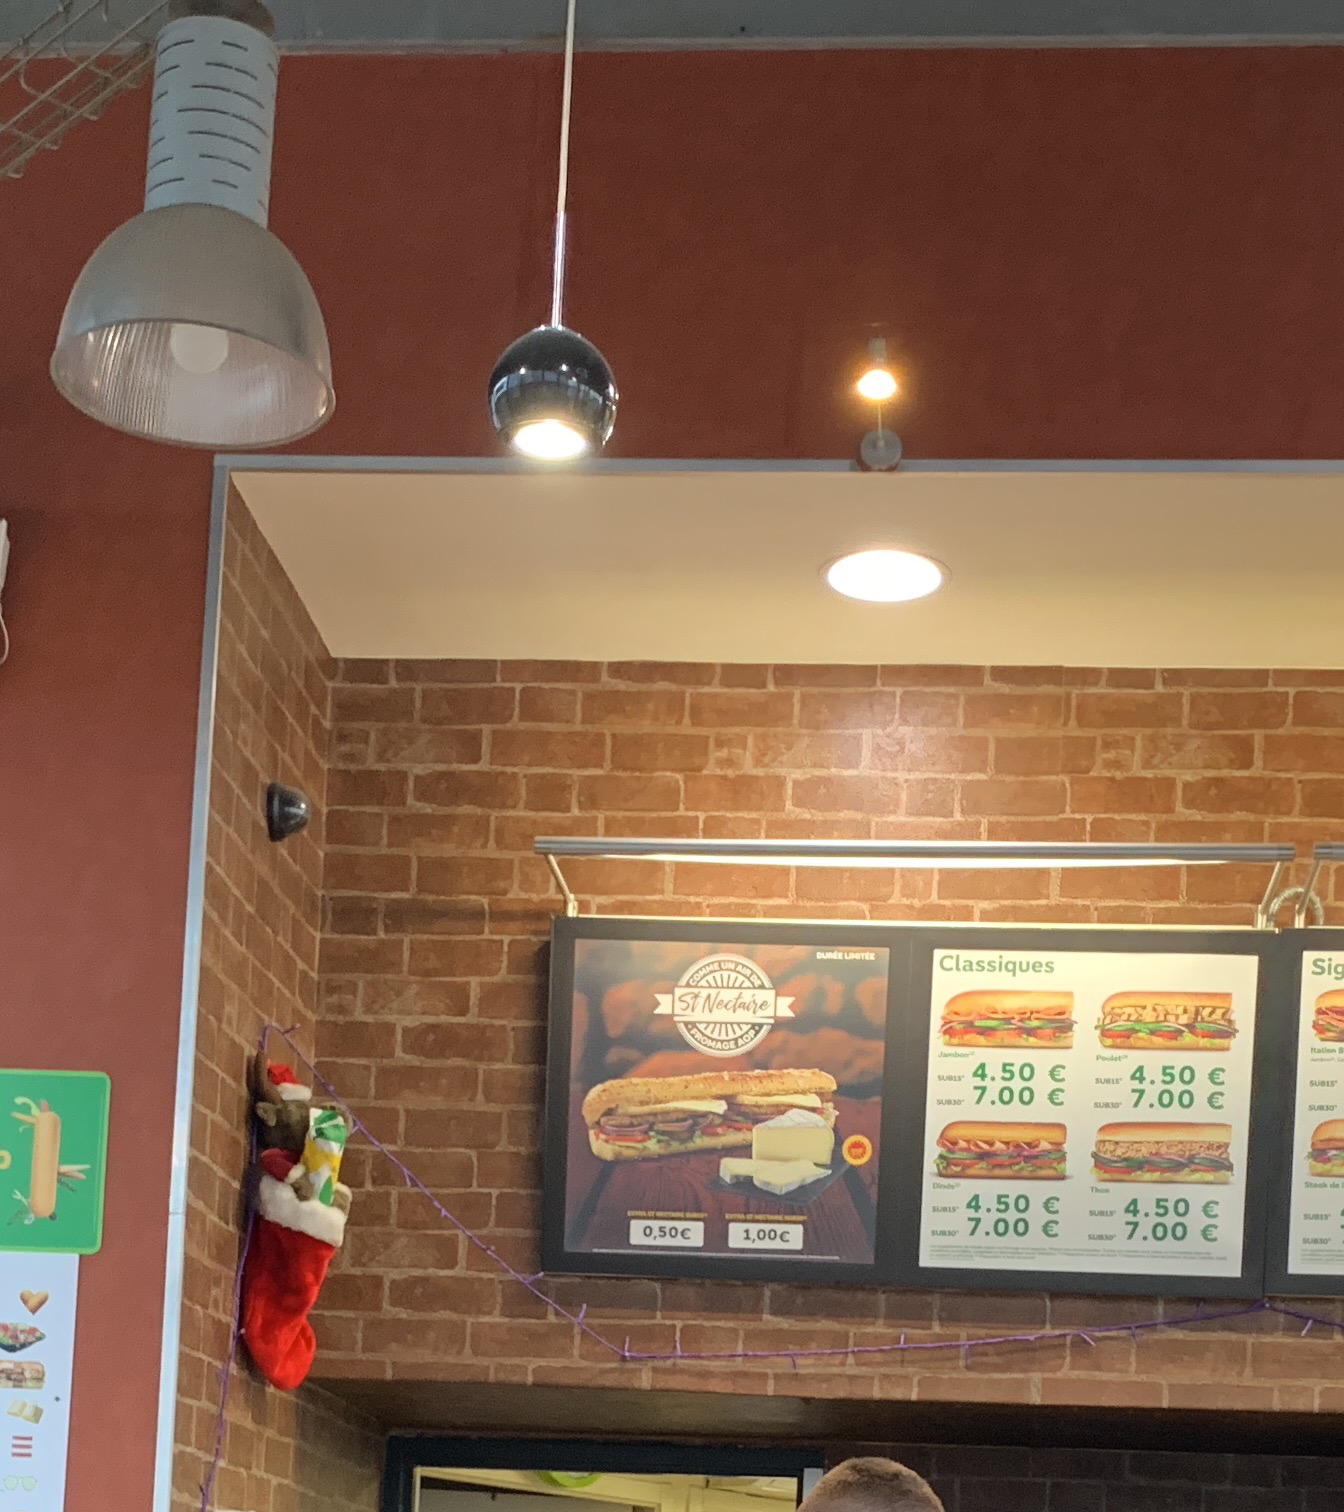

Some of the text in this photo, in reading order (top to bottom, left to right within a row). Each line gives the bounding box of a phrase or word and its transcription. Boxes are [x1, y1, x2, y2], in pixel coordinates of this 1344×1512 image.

[690, 961, 763, 988] COMME UN AIR DE
[939, 954, 1055, 977] Classiques
[678, 990, 771, 1014] St Nectaire
[689, 1028, 756, 1050] FROMAGE AOP
[972, 1062, 1035, 1082] 4.50
[1048, 1064, 1066, 1083] €
[1130, 1065, 1196, 1085] 4.50
[1207, 1067, 1226, 1086] €
[973, 1085, 1065, 1106] 7.00 €
[1130, 1088, 1225, 1110] 7.00 €
[966, 1194, 1030, 1214] 4.50
[1042, 1196, 1060, 1214] €
[1124, 1198, 1220, 1219] 4.50 €
[643, 1225, 691, 1241] 0,50€
[742, 1228, 790, 1244] 1,00€
[967, 1217, 1059, 1238] 7.00 €
[1124, 1221, 1219, 1242] 7.00 €
